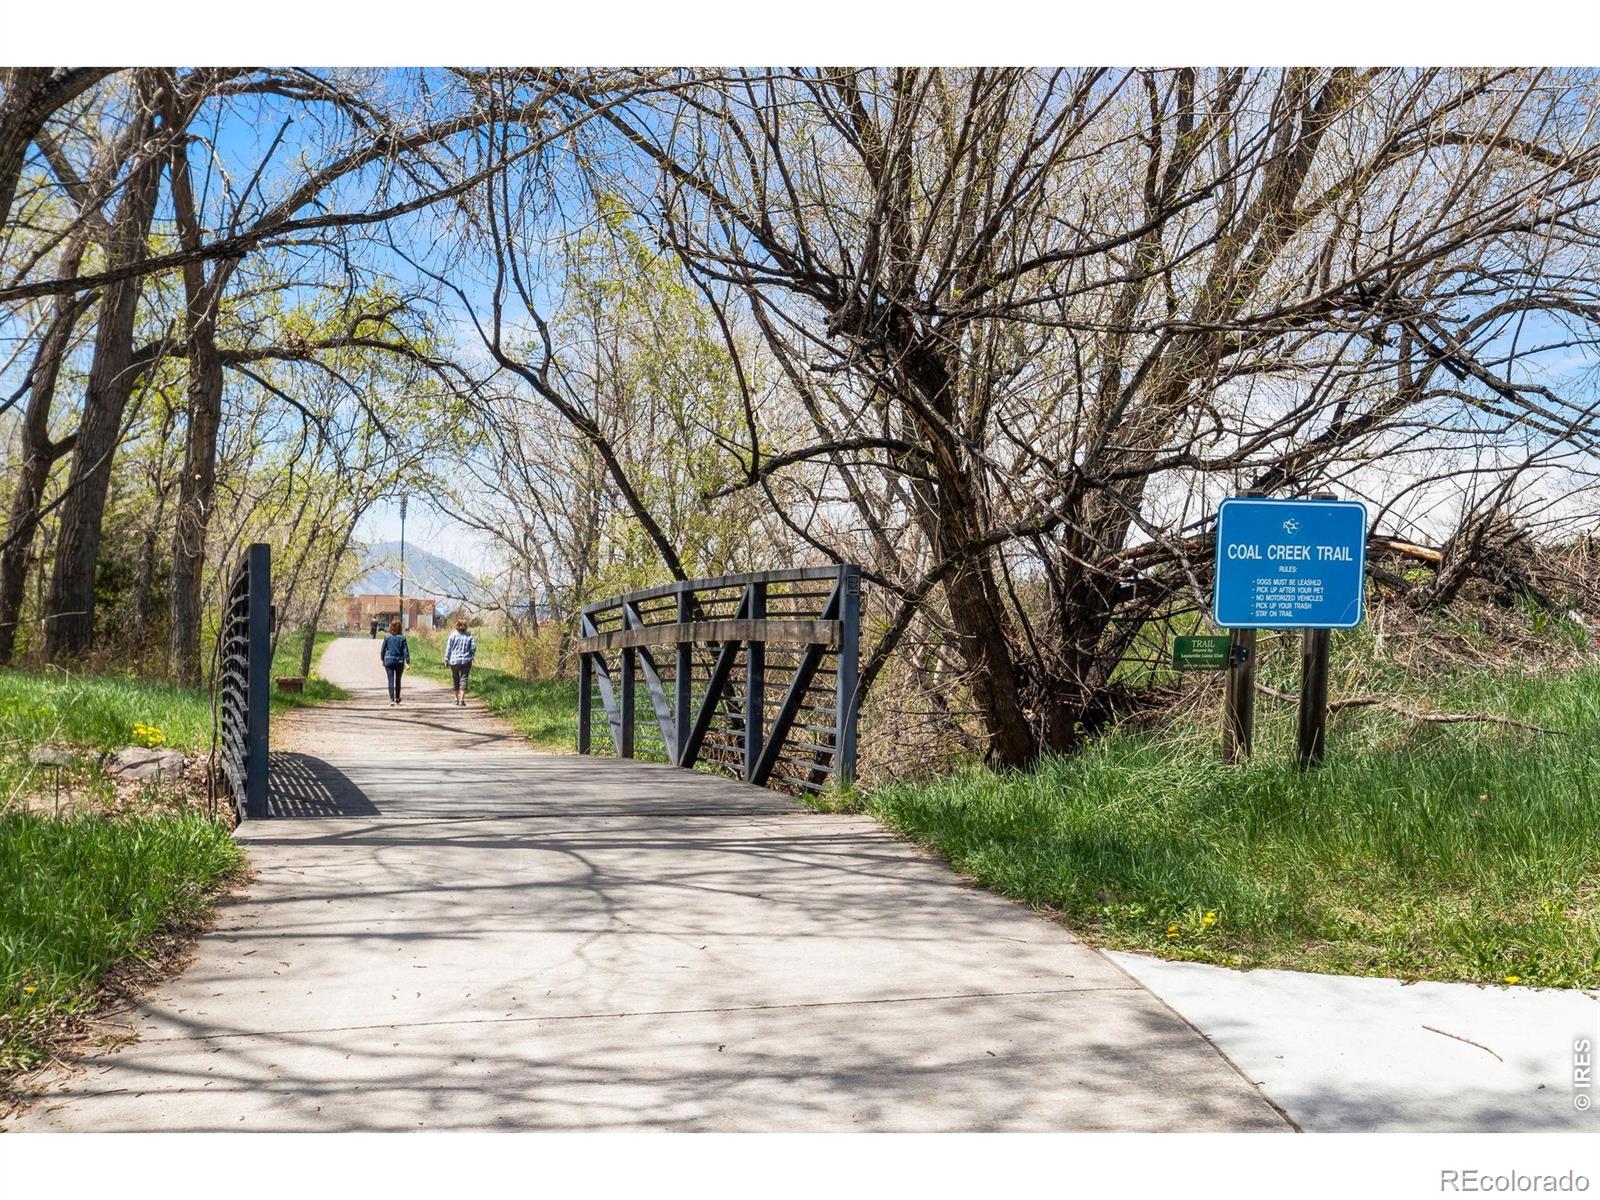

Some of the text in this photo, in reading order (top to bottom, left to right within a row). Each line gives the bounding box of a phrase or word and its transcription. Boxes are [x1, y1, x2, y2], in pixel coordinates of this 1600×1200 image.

[1228, 544, 1353, 561] COAL CREEK TRAIL
[1256, 578, 1272, 586] DOGS
[1273, 578, 1287, 586] MUST
[1288, 578, 1296, 586] BE
[1297, 578, 1322, 586] LEASHED
[1256, 586, 1269, 594] PICK
[1270, 586, 1278, 594] UP
[1278, 586, 1296, 594] AFTER
[1255, 594, 1265, 602] NO
[1265, 594, 1296, 602] MOTORIZED
[1255, 602, 1269, 610] PICK
[1269, 602, 1278, 610] UP
[1278, 602, 1293, 610] YOUR
[1255, 610, 1269, 618] STAY
[1192, 640, 1215, 648] TRAIL
